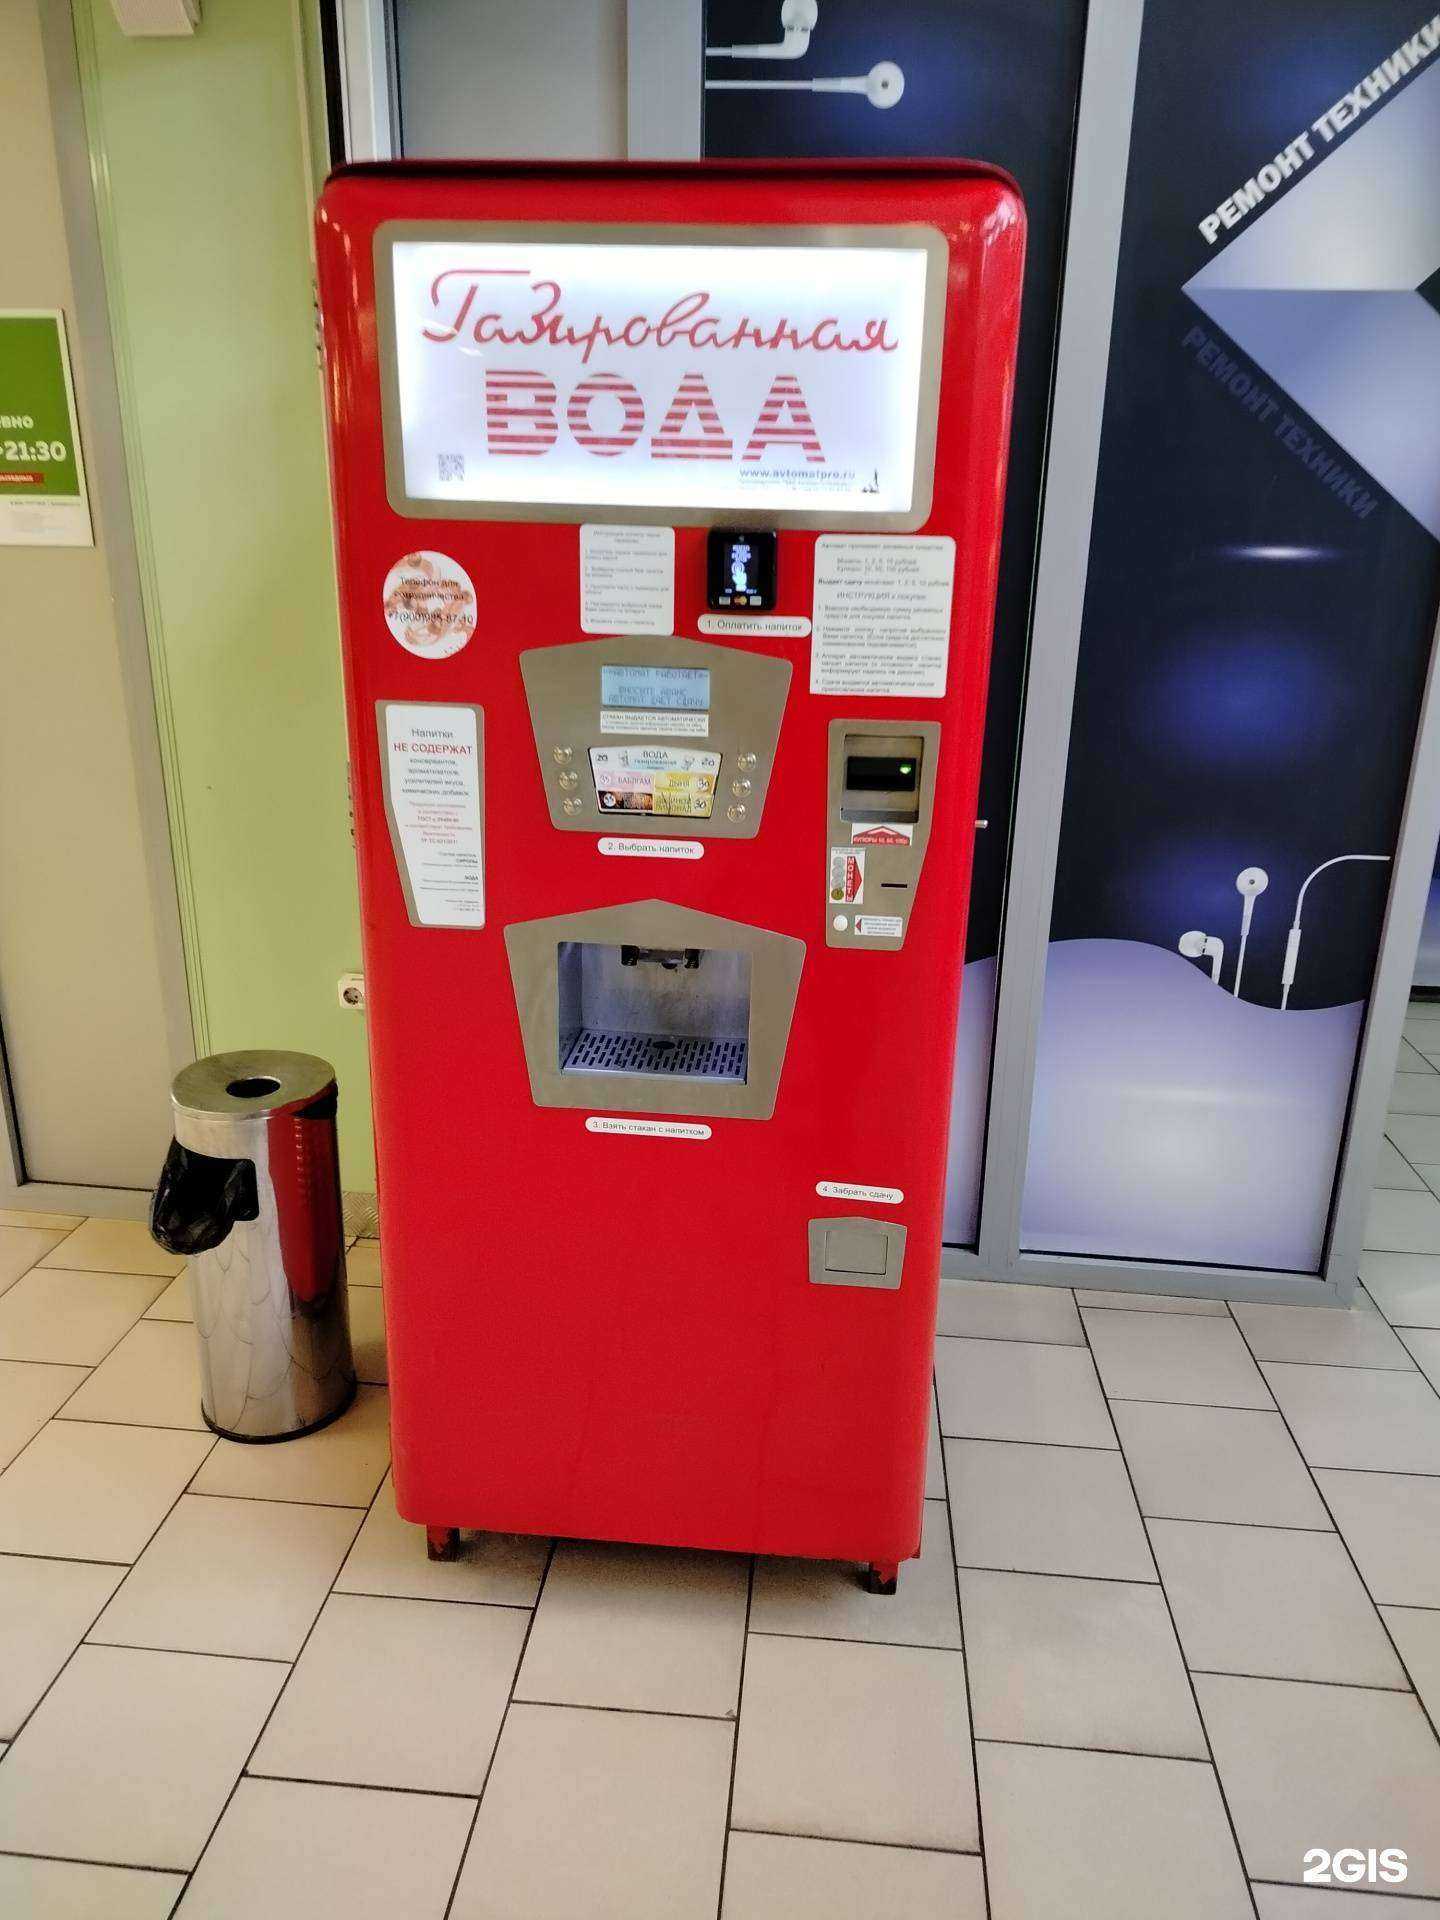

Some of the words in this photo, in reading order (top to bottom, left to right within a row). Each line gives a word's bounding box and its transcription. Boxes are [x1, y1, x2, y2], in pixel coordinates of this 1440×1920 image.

[1198, 131, 1315, 245] РЕМОНТ
[1310, 13, 1440, 142] ТЕХНИКИ
[421, 267, 900, 364] Газированная
[0, 415, 34, 429] ВНО
[484, 369, 826, 464] ВОДА
[1181, 325, 1280, 422] РЕМОНТ
[1274, 413, 1379, 520] ТЕХНИКИ
[739, 468, 856, 481] www.avtomatpro.ru
[707, 618, 715, 628] 1.
[717, 619, 762, 631] Оплатить
[765, 622, 803, 632] напиток
[411, 728, 454, 738] Напитки
[393, 742, 409, 752] НЕ
[411, 743, 472, 755] СОДЕРЖАТ
[642, 750, 669, 760] ВОДА
[608, 841, 616, 850] 2.
[618, 842, 657, 853] Выбрать
[659, 846, 694, 855] напиток
[846, 856, 855, 902] МОНЕТЫ
[592, 1121, 601, 1129] 3.
[602, 1121, 627, 1130] Взять
[628, 1124, 657, 1132] стакан
[665, 1128, 705, 1137] напитком
[822, 1185, 830, 1193] 4.
[832, 1186, 867, 1197] Забрать
[869, 1192, 894, 1201] сдачу
